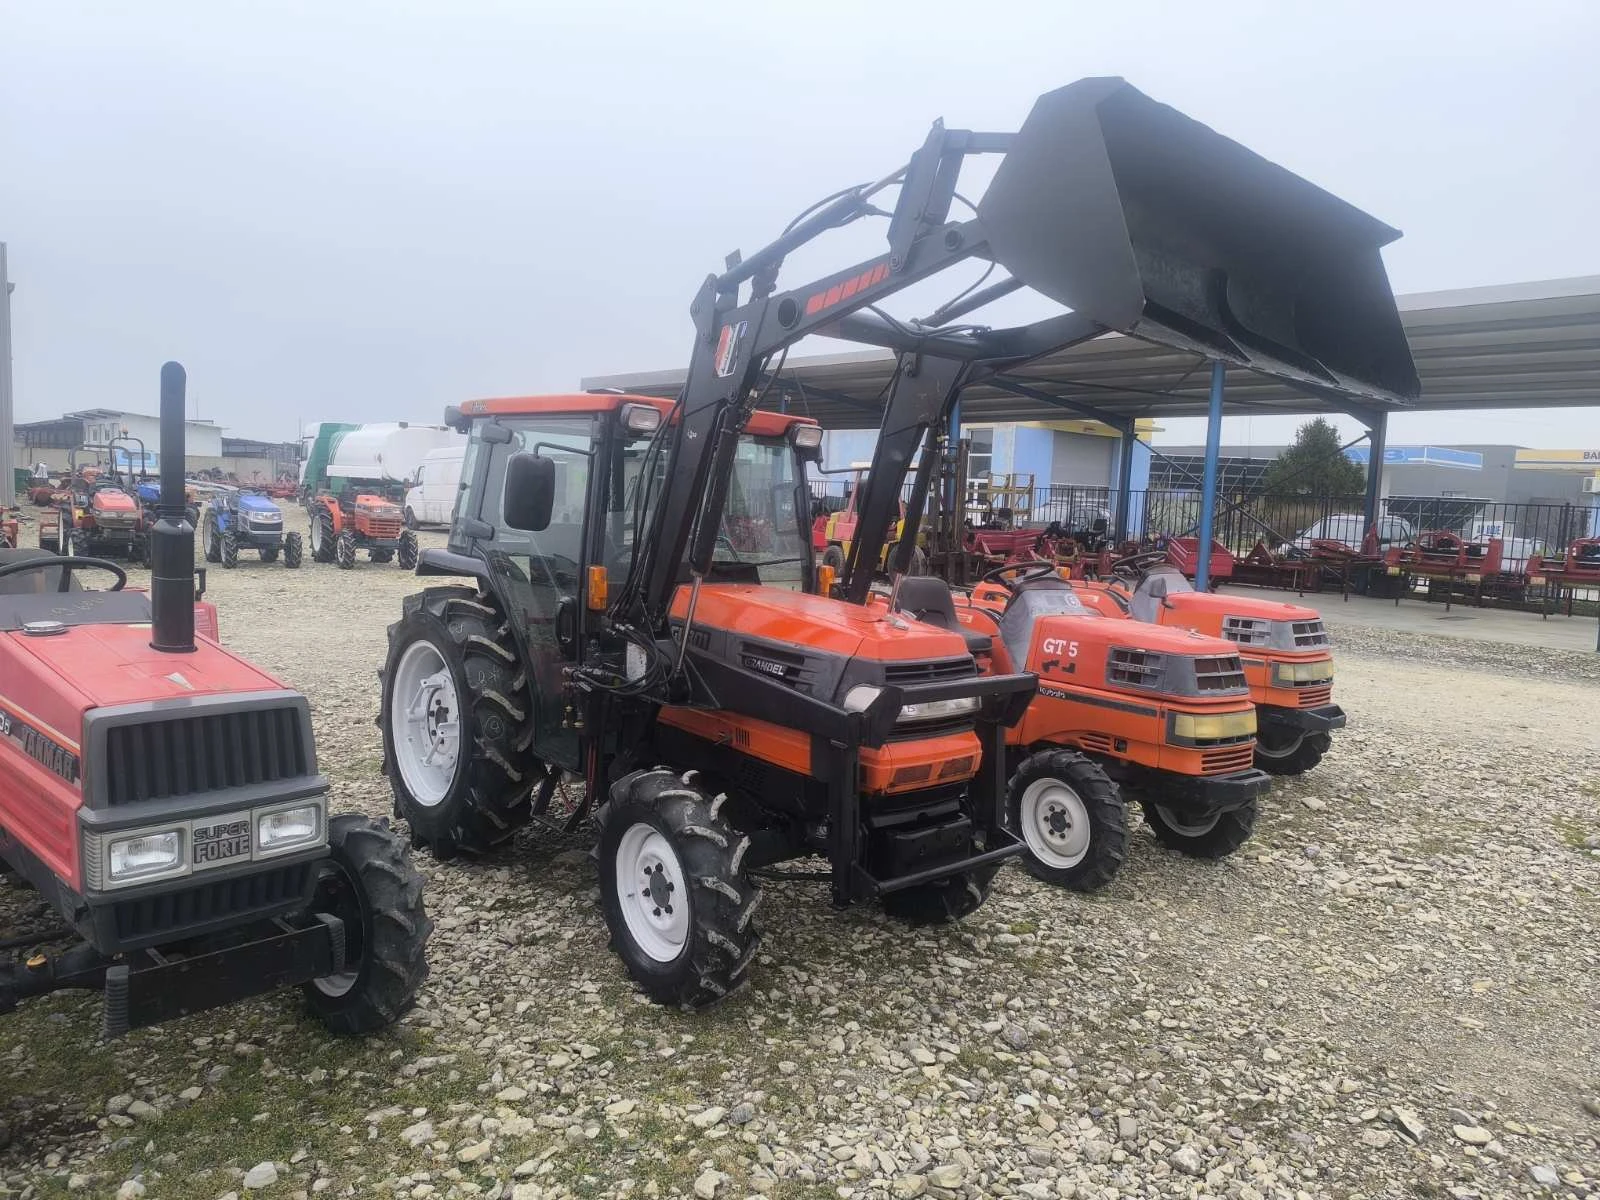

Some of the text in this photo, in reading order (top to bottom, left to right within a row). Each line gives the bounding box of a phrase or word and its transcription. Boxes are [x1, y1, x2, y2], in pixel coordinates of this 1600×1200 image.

[1043, 637, 1079, 658] GT 5
[22, 724, 75, 784] YANMAR
[194, 820, 250, 843] SUPER
[194, 834, 250, 864] FORTE
